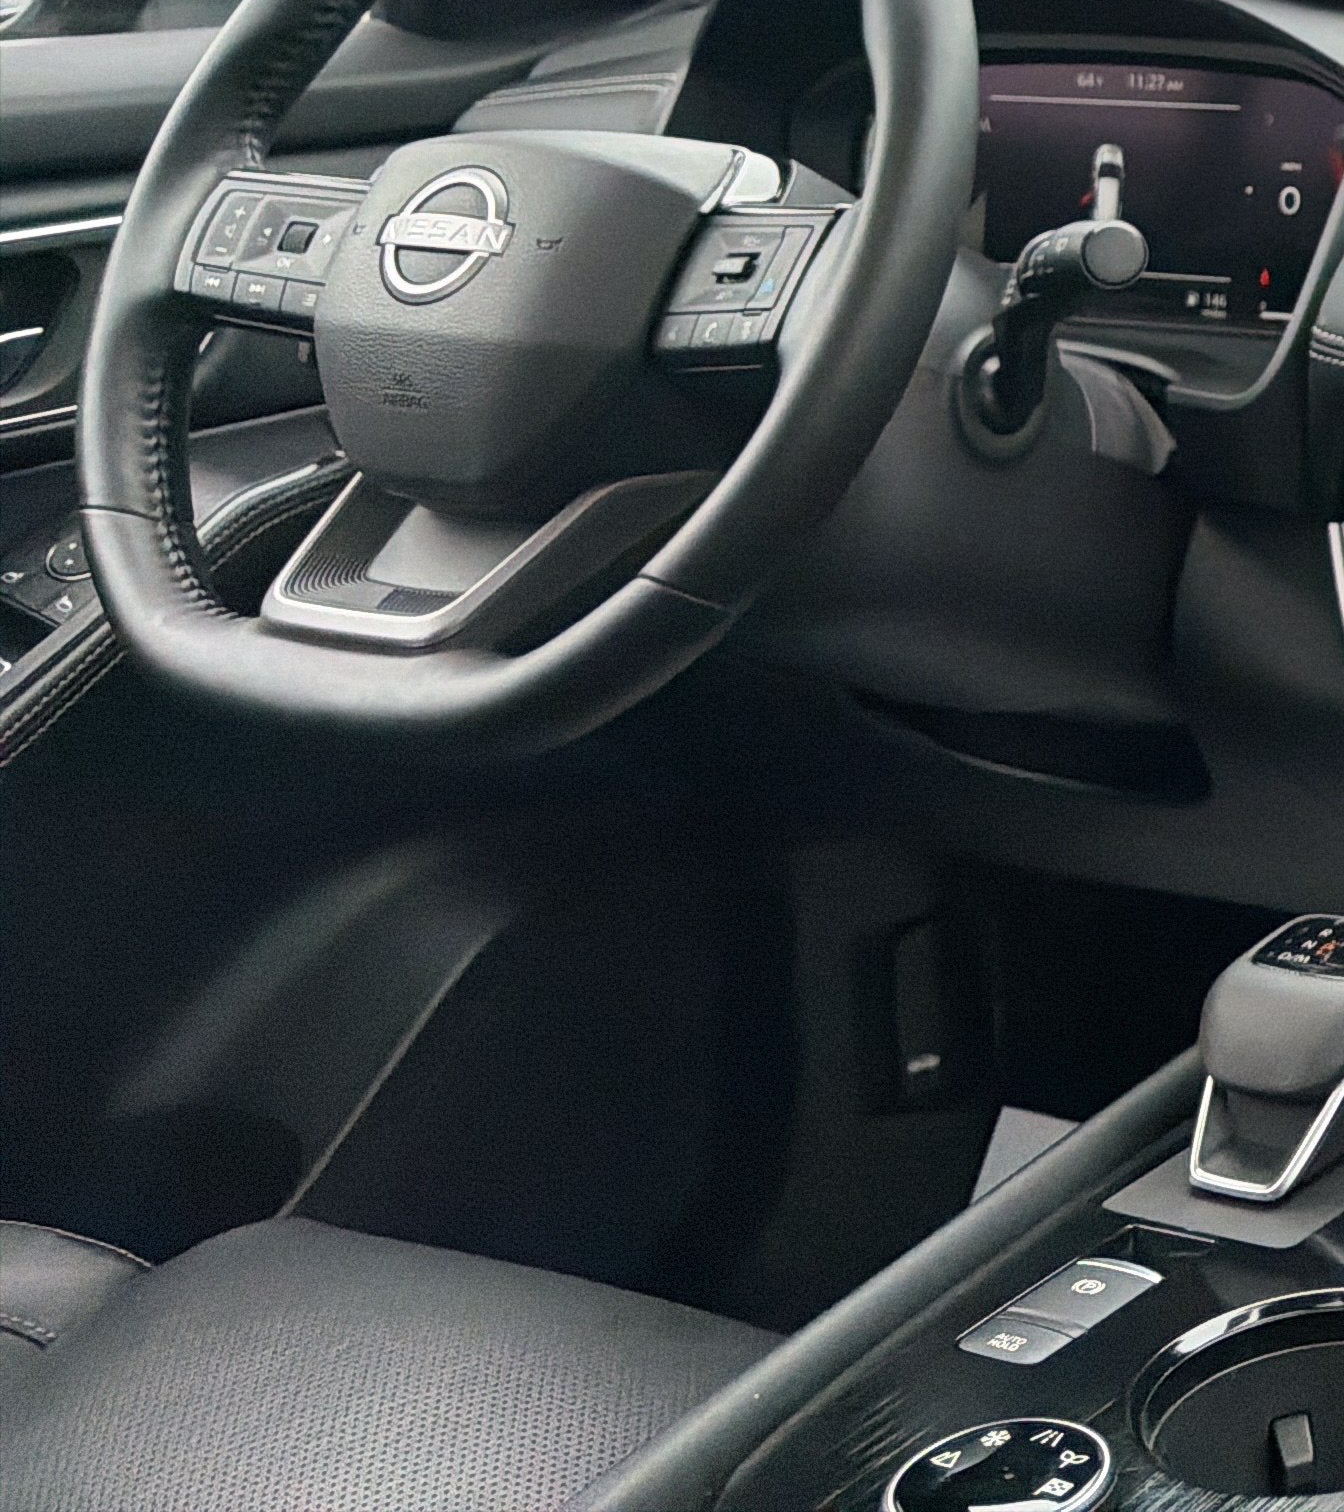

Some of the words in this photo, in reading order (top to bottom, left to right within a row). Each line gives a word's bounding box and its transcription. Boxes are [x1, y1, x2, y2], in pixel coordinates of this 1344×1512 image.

[1279, 186, 1302, 216] 0
[382, 217, 509, 250] NISSAN
[1301, 939, 1318, 950] N
[986, 1339, 1021, 1352] HOLD
[994, 1332, 1028, 1346] AUTO
